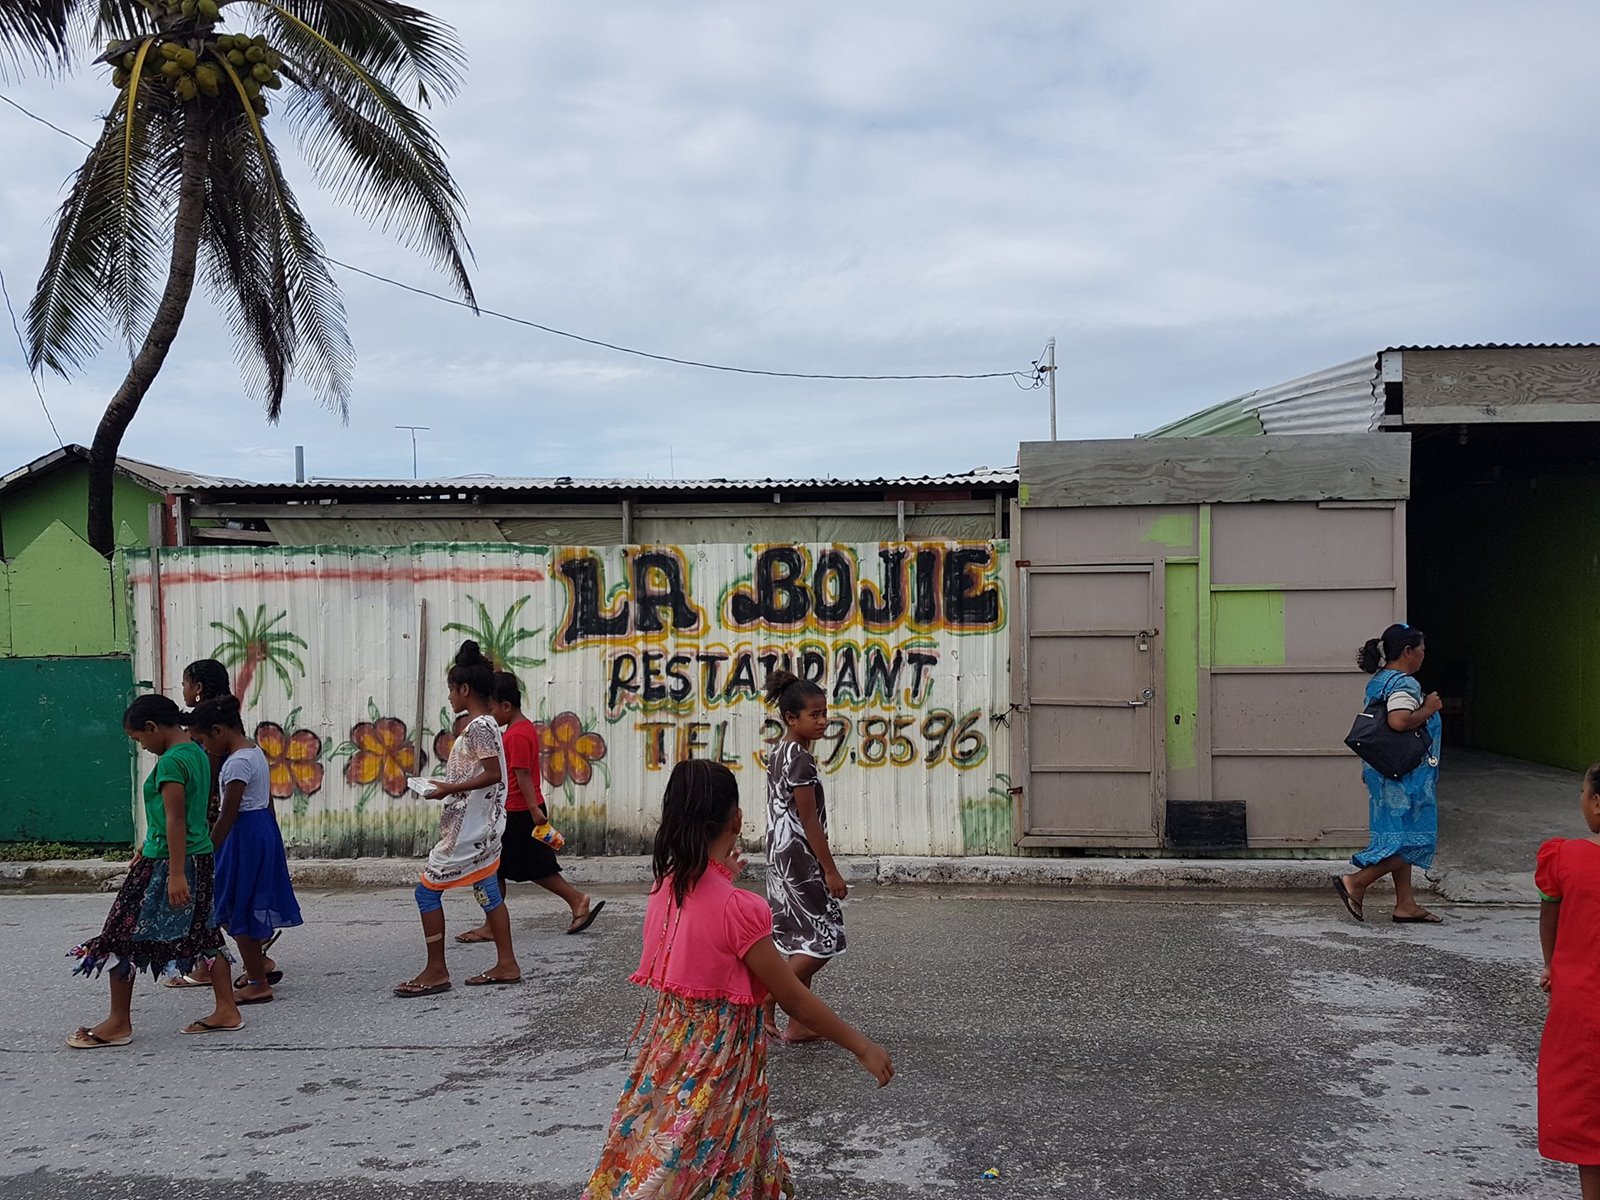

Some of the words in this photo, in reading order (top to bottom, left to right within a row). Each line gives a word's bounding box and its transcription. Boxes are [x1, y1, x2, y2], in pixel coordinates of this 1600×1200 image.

[559, 550, 699, 645] LA
[730, 546, 1000, 625] BOJIE
[634, 719, 741, 768] TEL
[756, 711, 987, 767] 39.8596
